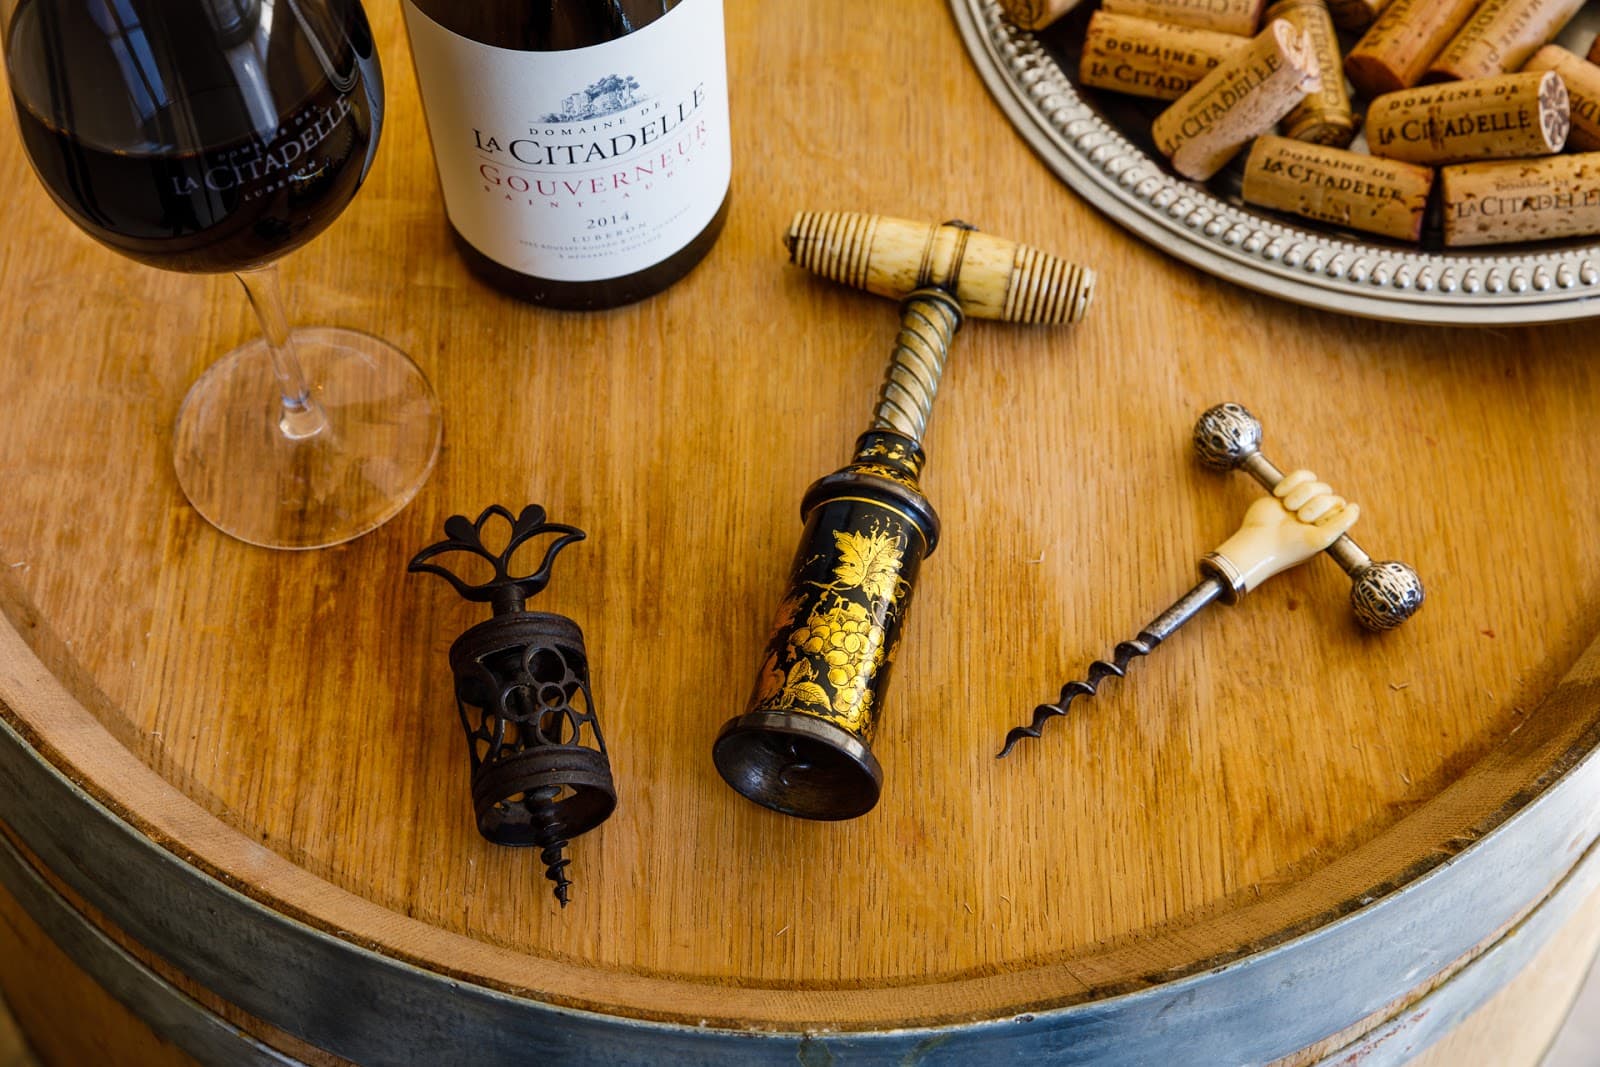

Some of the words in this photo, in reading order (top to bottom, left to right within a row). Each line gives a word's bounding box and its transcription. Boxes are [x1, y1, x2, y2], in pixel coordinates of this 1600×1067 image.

[1452, 0, 1505, 63] ADELLE
[1502, 0, 1546, 47] MAINE
[1105, 38, 1197, 66] DOMAINE
[1091, 61, 1109, 78] LA
[1114, 63, 1194, 93] CITAD
[1182, 54, 1281, 138] CITADELLE
[1389, 88, 1483, 112] DOMAINE
[1495, 85, 1520, 97] DE
[472, 127, 504, 154] LA
[509, 81, 706, 166] CITADELLE
[529, 117, 627, 136] DOMAINE
[641, 101, 662, 116] DE
[172, 175, 200, 196] LA
[205, 93, 351, 191] CITADELLE
[1378, 127, 1396, 145] LA
[480, 119, 707, 196] GOUVERNEUR
[1279, 149, 1365, 173] DOMAINE
[1372, 168, 1397, 181] DE
[1262, 158, 1282, 174] LA
[1288, 163, 1402, 200] CITADELLE
[586, 211, 630, 230] 2014
[1457, 201, 1477, 219] LA
[1480, 191, 1600, 217] CITADELL
[572, 221, 647, 243] LUBERON
